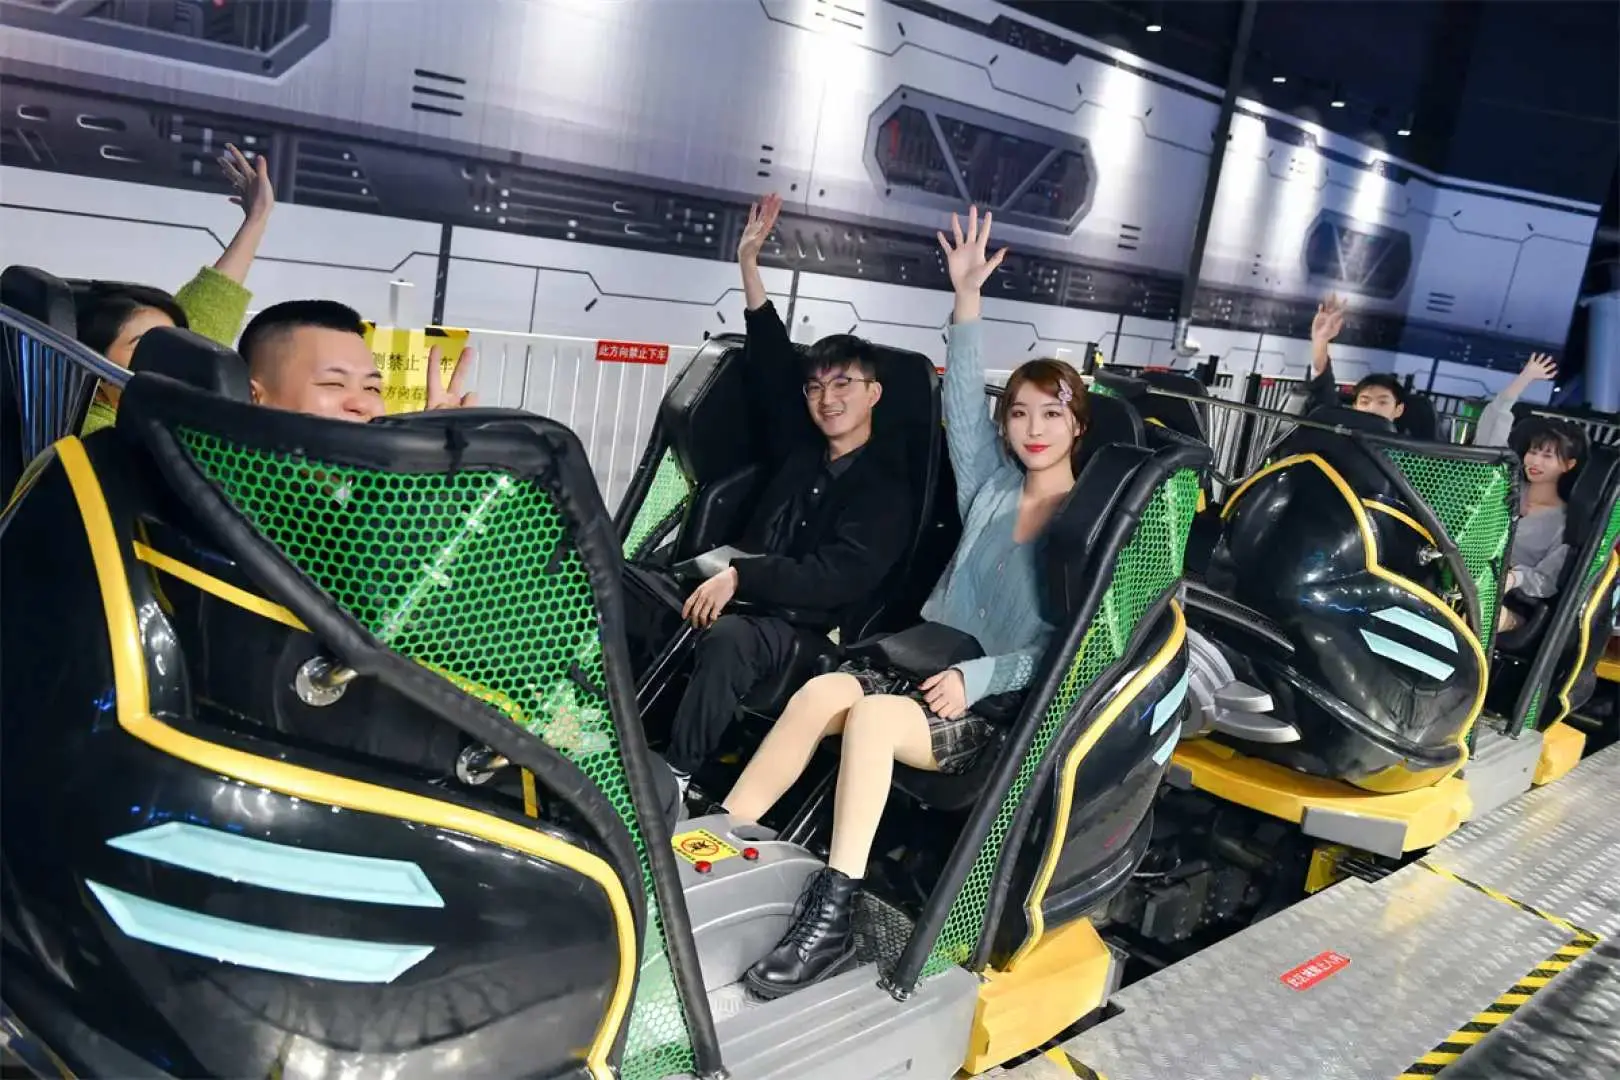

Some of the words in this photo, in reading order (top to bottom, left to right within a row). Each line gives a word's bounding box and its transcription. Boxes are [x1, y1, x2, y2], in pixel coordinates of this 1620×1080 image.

[598, 344, 667, 361] 此方向禁止下车
[372, 352, 454, 373] 侧禁止车
